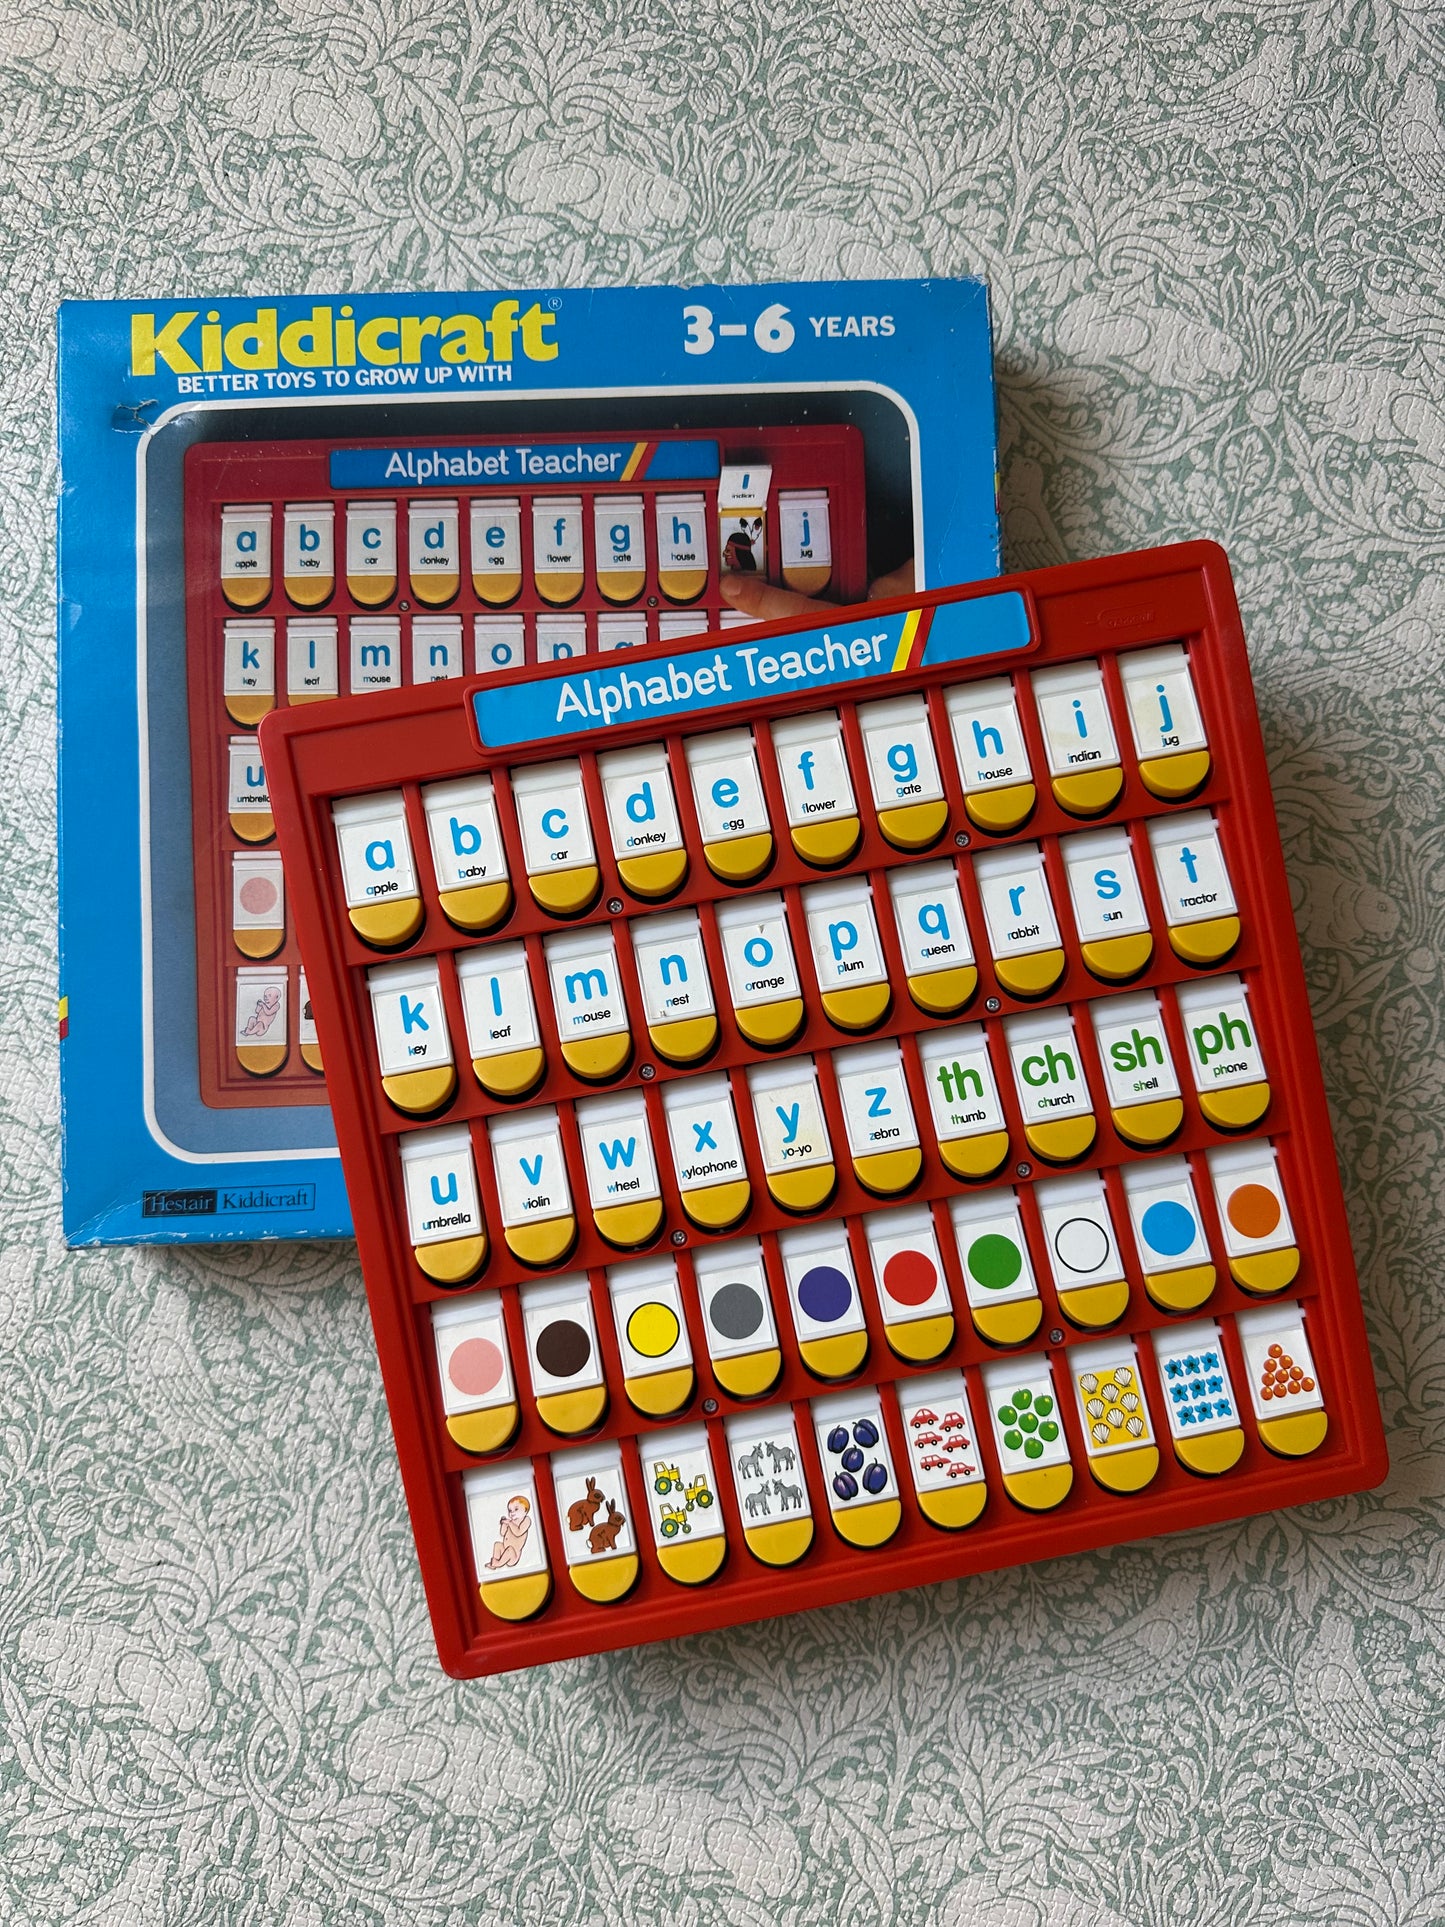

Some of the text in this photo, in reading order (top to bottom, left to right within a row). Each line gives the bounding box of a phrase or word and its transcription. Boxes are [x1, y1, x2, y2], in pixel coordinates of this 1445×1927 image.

[809, 316, 895, 337] YEARS
[178, 365, 512, 393] BETTER TOYS TO GROW UP WITH
[385, 447, 621, 484] Alphabet Teacher
[300, 524, 320, 551] b
[362, 528, 381, 549] c
[424, 521, 444, 549] d
[486, 526, 505, 548] e
[553, 518, 566, 546] f
[610, 524, 630, 552] g
[673, 517, 691, 544] h
[800, 513, 811, 546] j
[236, 531, 256, 552] a
[235, 560, 257, 569] apple
[300, 559, 320, 568] baby
[365, 557, 378, 565] car
[420, 556, 449, 566] donkey
[489, 556, 504, 565] egg
[547, 554, 571, 562] flower
[613, 554, 631, 562] gate
[671, 552, 695, 561] house
[800, 550, 813, 558] jug
[242, 641, 260, 668] k
[309, 641, 315, 668] l
[361, 645, 390, 667] m
[430, 645, 448, 666] n
[491, 643, 512, 665] o
[243, 677, 257, 686] key
[305, 677, 320, 685] leaf
[363, 675, 391, 683] mouse
[556, 633, 887, 725] Alphabet Teacher
[1156, 684, 1173, 732] j
[1072, 700, 1088, 738] i
[972, 720, 1004, 758] h
[1162, 734, 1180, 747] jug
[887, 743, 918, 782] g
[1067, 750, 1101, 763] indian
[247, 766, 264, 787] u
[798, 751, 814, 790] f
[978, 766, 1012, 780] house
[712, 778, 739, 808] e
[896, 783, 921, 797] gate
[625, 782, 656, 823] d
[802, 800, 836, 814] flower
[542, 809, 569, 838] c
[722, 818, 744, 831] egg
[450, 817, 481, 856] b
[627, 831, 666, 846] donkey
[365, 840, 395, 871] a
[551, 849, 568, 861] car
[1180, 847, 1198, 883] t
[458, 865, 486, 878] baby
[366, 881, 398, 896] apple
[1094, 870, 1121, 899] s
[1009, 885, 1025, 916] r
[1180, 892, 1217, 907] tractor
[918, 903, 950, 940] q
[1103, 910, 1122, 921] sun
[828, 920, 858, 960] p
[1008, 925, 1040, 941] rabbit
[744, 938, 774, 967] o
[921, 944, 955, 958] queen
[660, 954, 688, 986] n
[837, 960, 864, 975] plum
[565, 968, 608, 1003] m
[745, 975, 784, 991] orange
[490, 977, 502, 1016] l
[666, 994, 689, 1007] nest
[400, 995, 429, 1034] k
[573, 1009, 611, 1025] mouse
[489, 1025, 511, 1039] leaf
[1193, 1012, 1251, 1065] ph
[408, 1043, 427, 1056] key
[1110, 1029, 1164, 1072] sh
[1021, 1045, 1076, 1086] ch
[1213, 1060, 1248, 1077] phone
[937, 1062, 984, 1103] th
[1133, 1077, 1158, 1092] shell
[865, 1087, 891, 1118] z
[1038, 1093, 1074, 1108] church
[776, 1102, 799, 1143] y
[951, 1110, 986, 1125] thumb
[693, 1121, 717, 1152] x
[869, 1127, 900, 1140] zebra
[599, 1137, 636, 1170] w
[782, 1144, 812, 1159] yo-yo
[519, 1154, 543, 1186] v
[682, 1158, 737, 1179] xylophone
[430, 1172, 458, 1205] u
[607, 1178, 640, 1193] wheel
[150, 1189, 308, 1212] Hestair Kiddicraft
[522, 1196, 550, 1210] violin
[422, 1212, 470, 1230] umbrella
